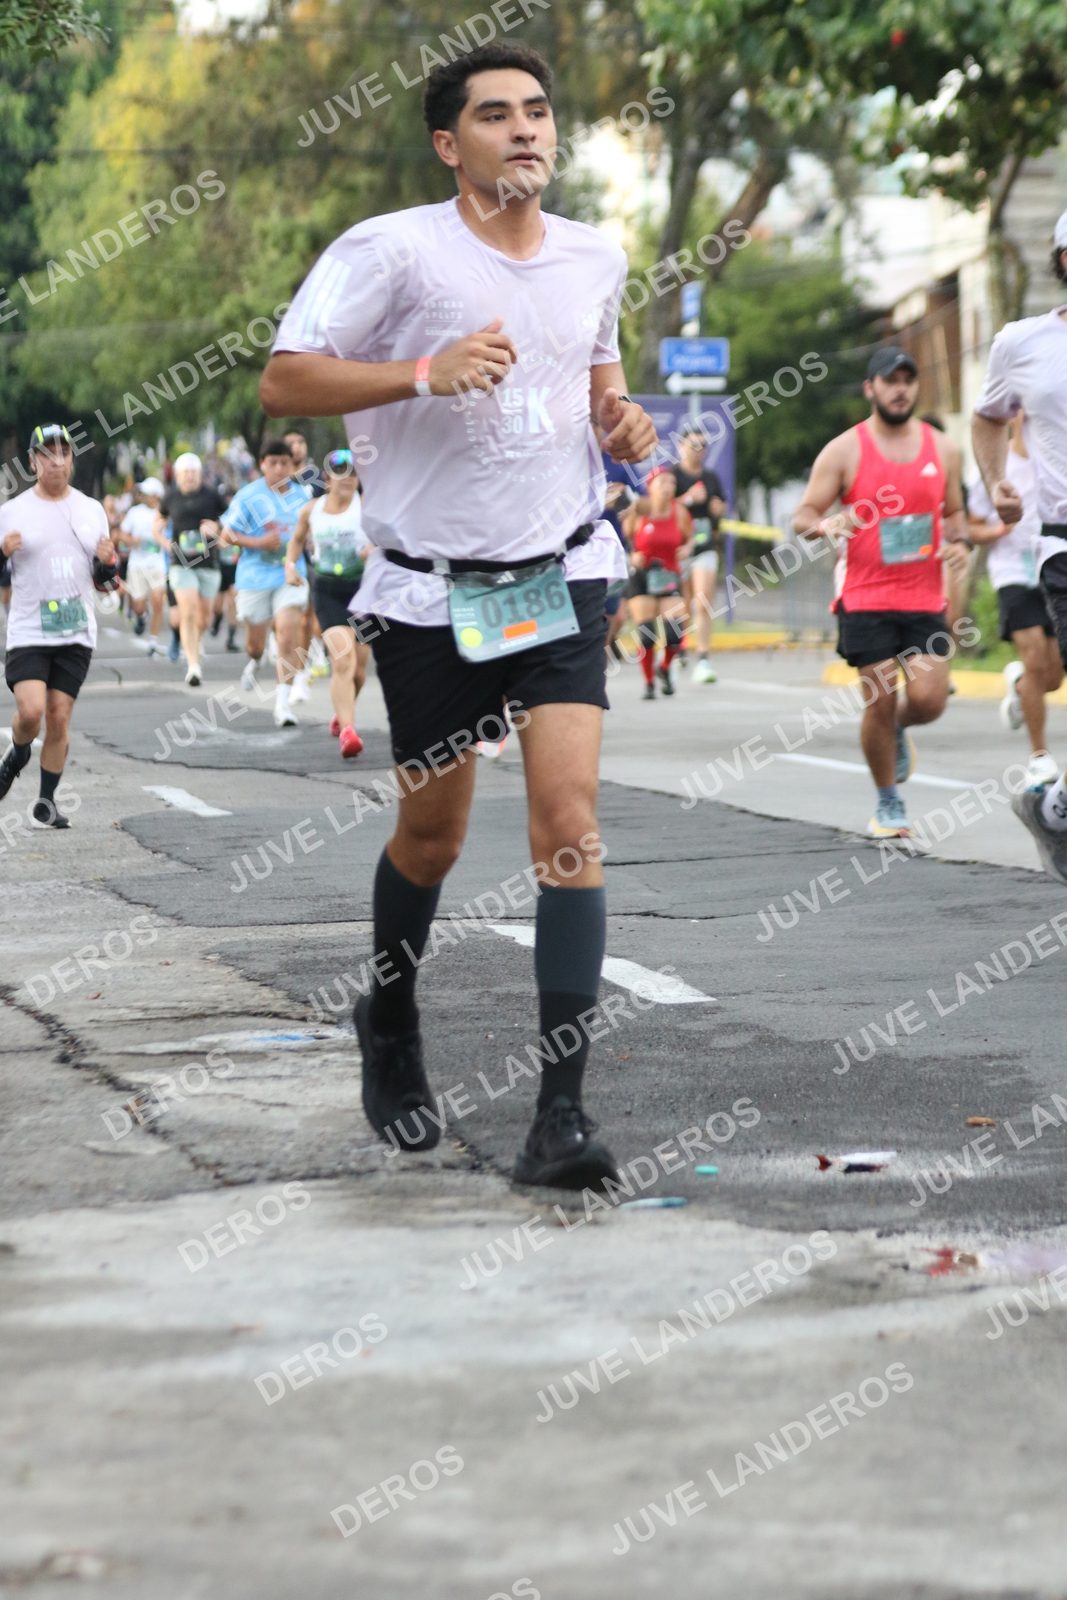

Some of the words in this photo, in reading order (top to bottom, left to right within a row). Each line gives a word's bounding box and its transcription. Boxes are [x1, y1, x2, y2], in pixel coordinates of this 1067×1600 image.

[502, 389, 524, 407] 15
[527, 387, 556, 434] K
[502, 415, 524, 434] 30
[481, 581, 565, 628] 0186
